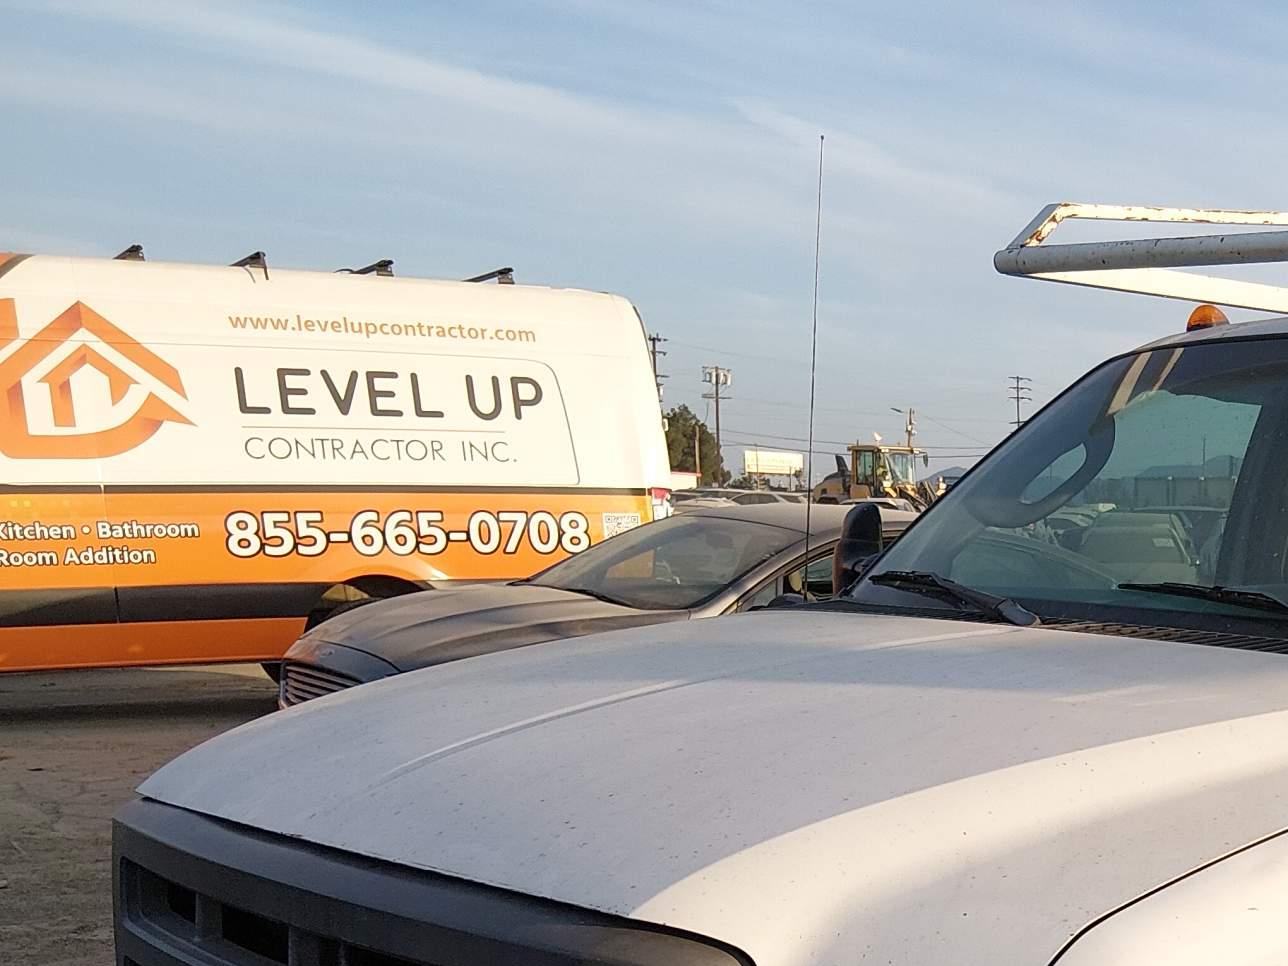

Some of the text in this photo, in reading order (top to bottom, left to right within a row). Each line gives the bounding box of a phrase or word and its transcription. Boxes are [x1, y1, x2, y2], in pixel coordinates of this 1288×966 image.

[228, 312, 537, 343] www.levelupcontractor.com
[234, 366, 544, 421] LEVEL UP
[243, 436, 519, 463] CONTRACTOR INC.
[96, 519, 201, 539] Bathroom
[225, 510, 592, 557] 855-665-0708
[63, 545, 156, 565] Addition
